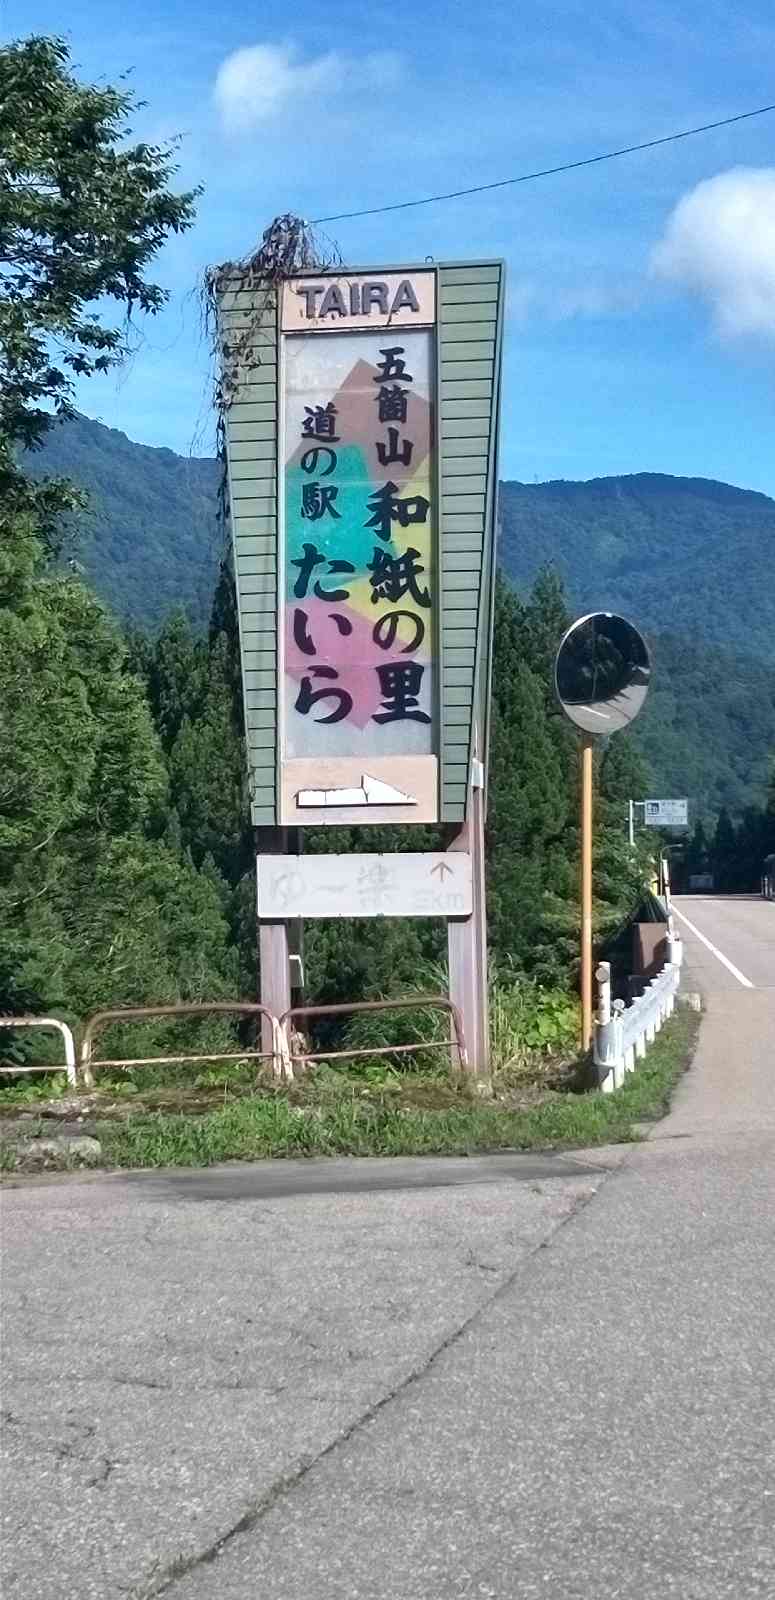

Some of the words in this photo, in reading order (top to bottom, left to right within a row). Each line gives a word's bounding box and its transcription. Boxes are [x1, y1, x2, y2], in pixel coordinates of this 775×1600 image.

[299, 280, 420, 318] TAIRA
[301, 402, 342, 521] 道の駅
[373, 347, 413, 467] 五箇山
[291, 543, 355, 724] たいら
[363, 480, 432, 725] 和紙の里
